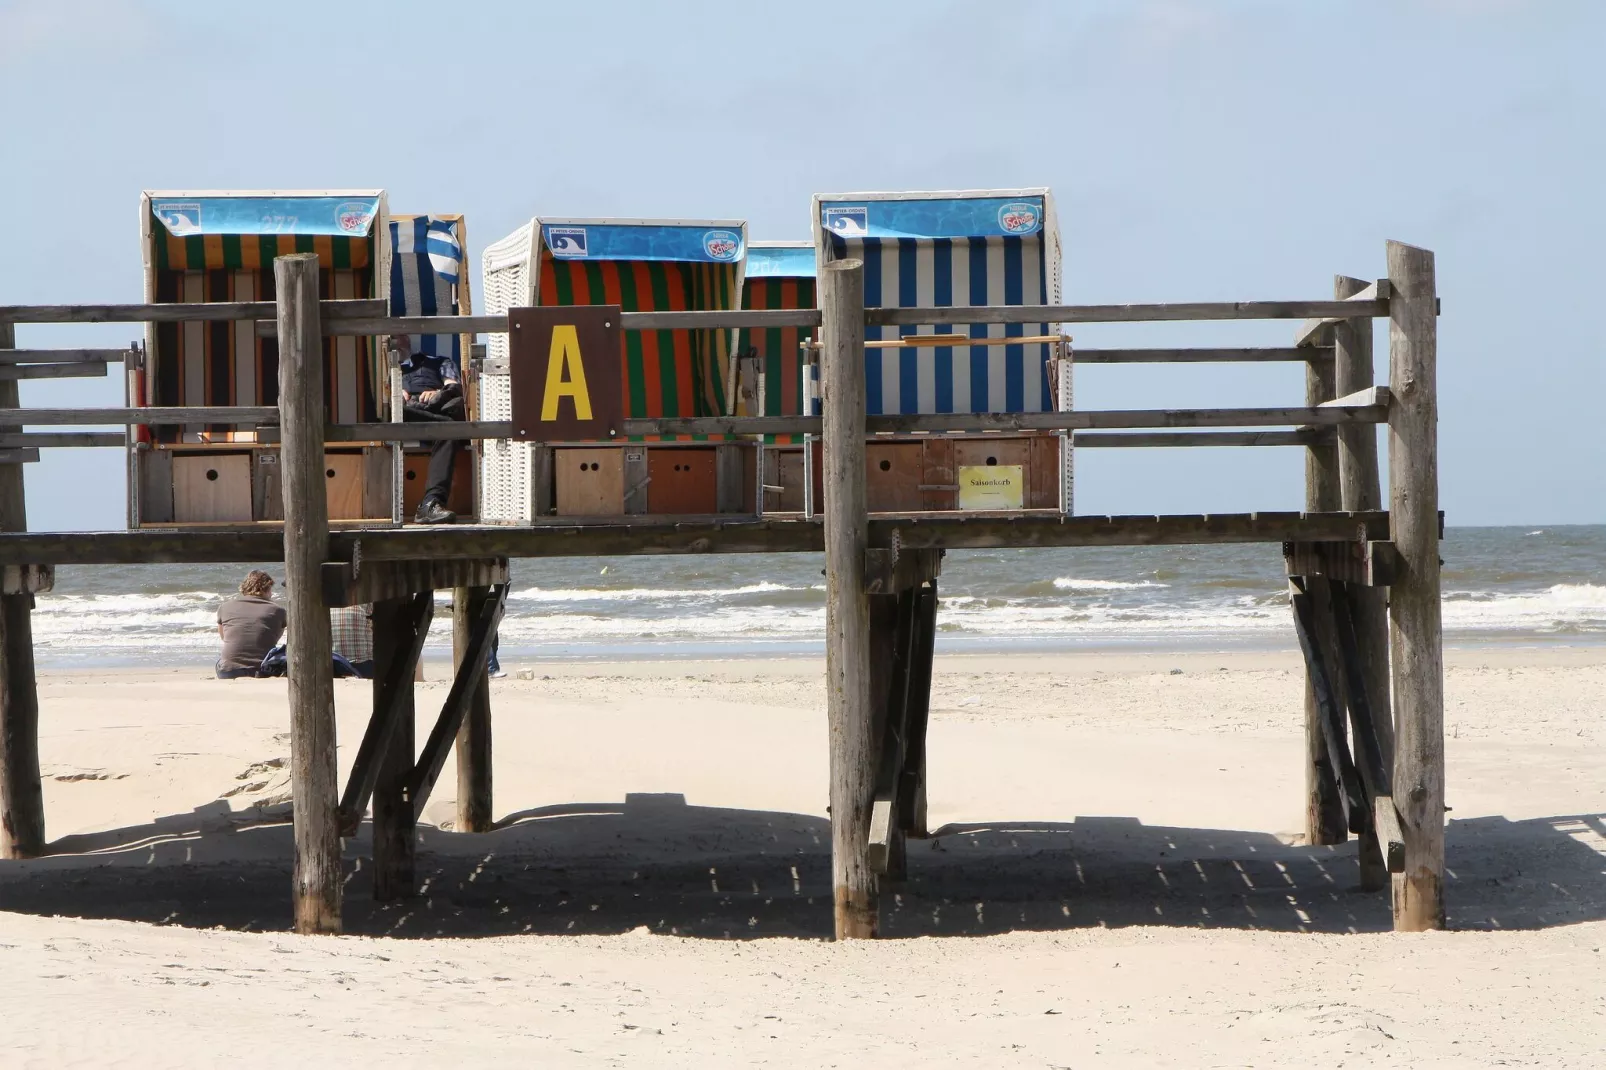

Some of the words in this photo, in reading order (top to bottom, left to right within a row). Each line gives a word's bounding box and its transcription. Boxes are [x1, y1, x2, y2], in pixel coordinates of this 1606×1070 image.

[262, 215, 299, 233] 277
[541, 325, 593, 421] A
[970, 478, 1011, 487] Saisonkorb
